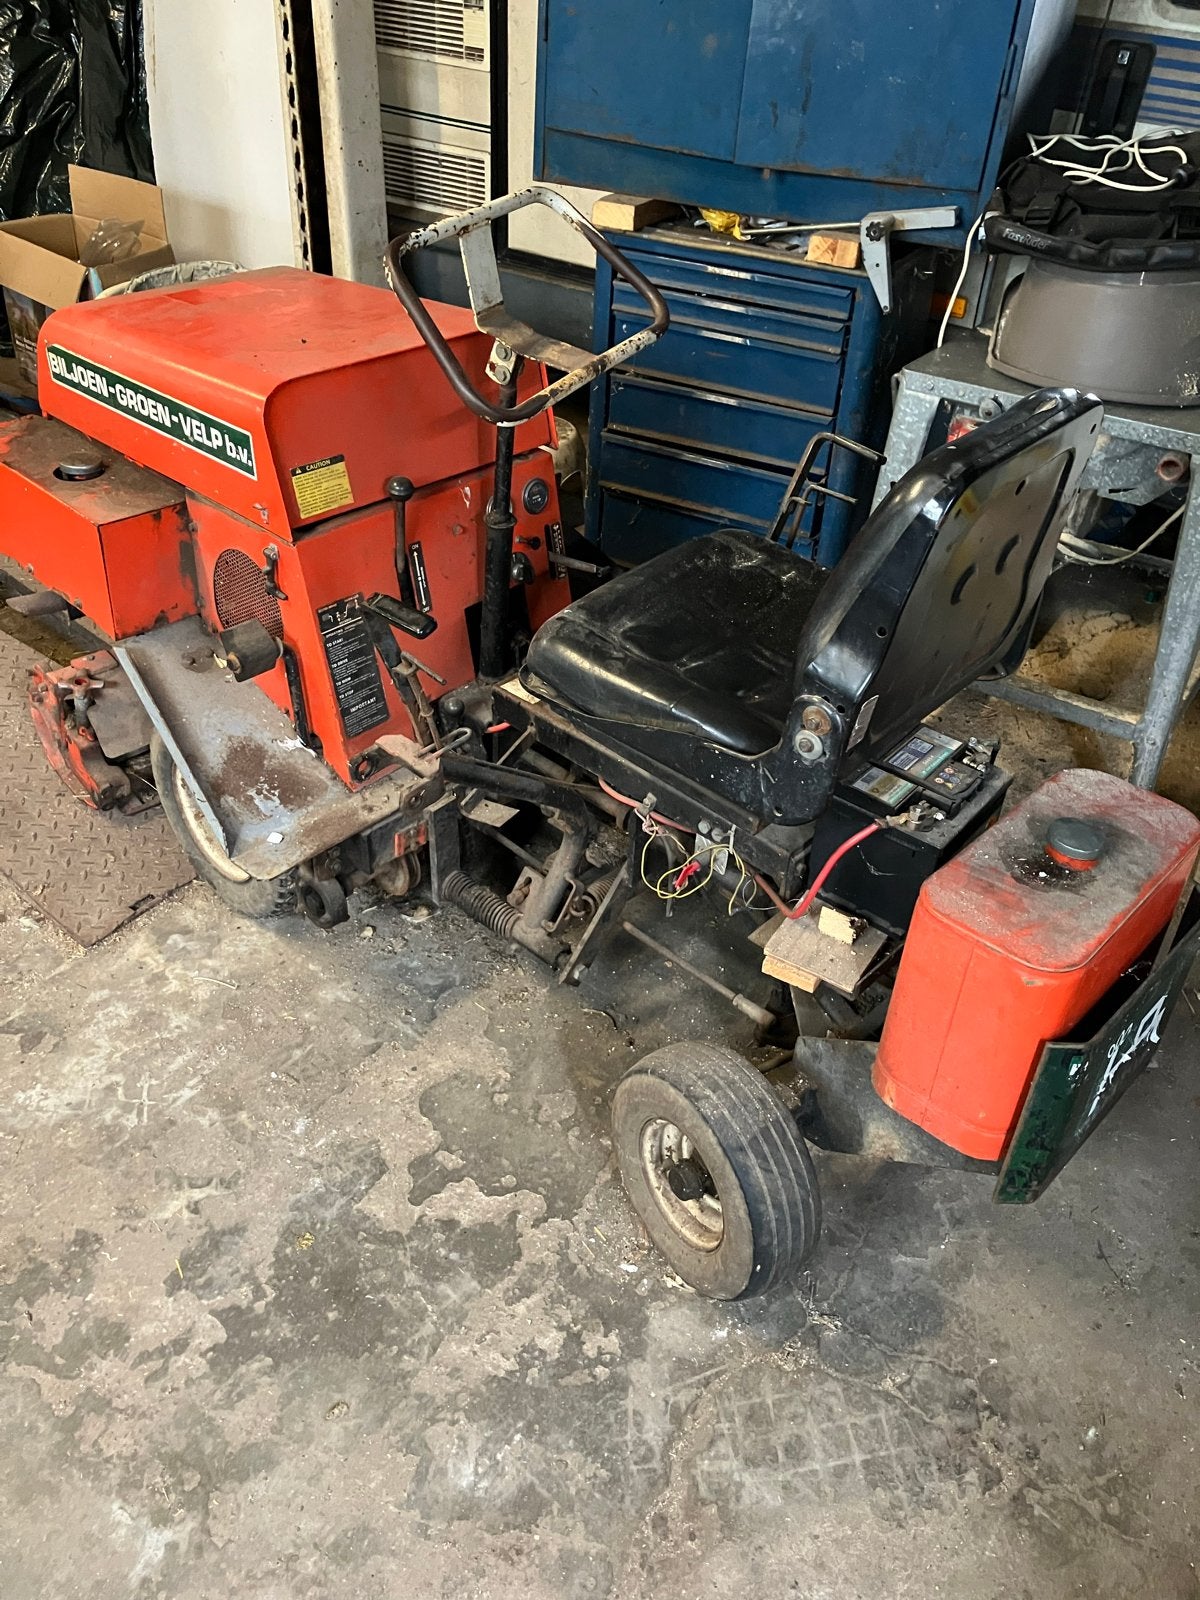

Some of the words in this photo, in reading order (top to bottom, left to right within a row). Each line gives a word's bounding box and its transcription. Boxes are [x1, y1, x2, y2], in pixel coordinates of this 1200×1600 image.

[1002, 228, 1049, 250] FastRider
[48, 352, 223, 449] BILJOEN-GROEN-VELP
[224, 433, 253, 466] b.v.
[305, 459, 331, 471] CAUTION
[349, 697, 377, 713] IMPORTANT
